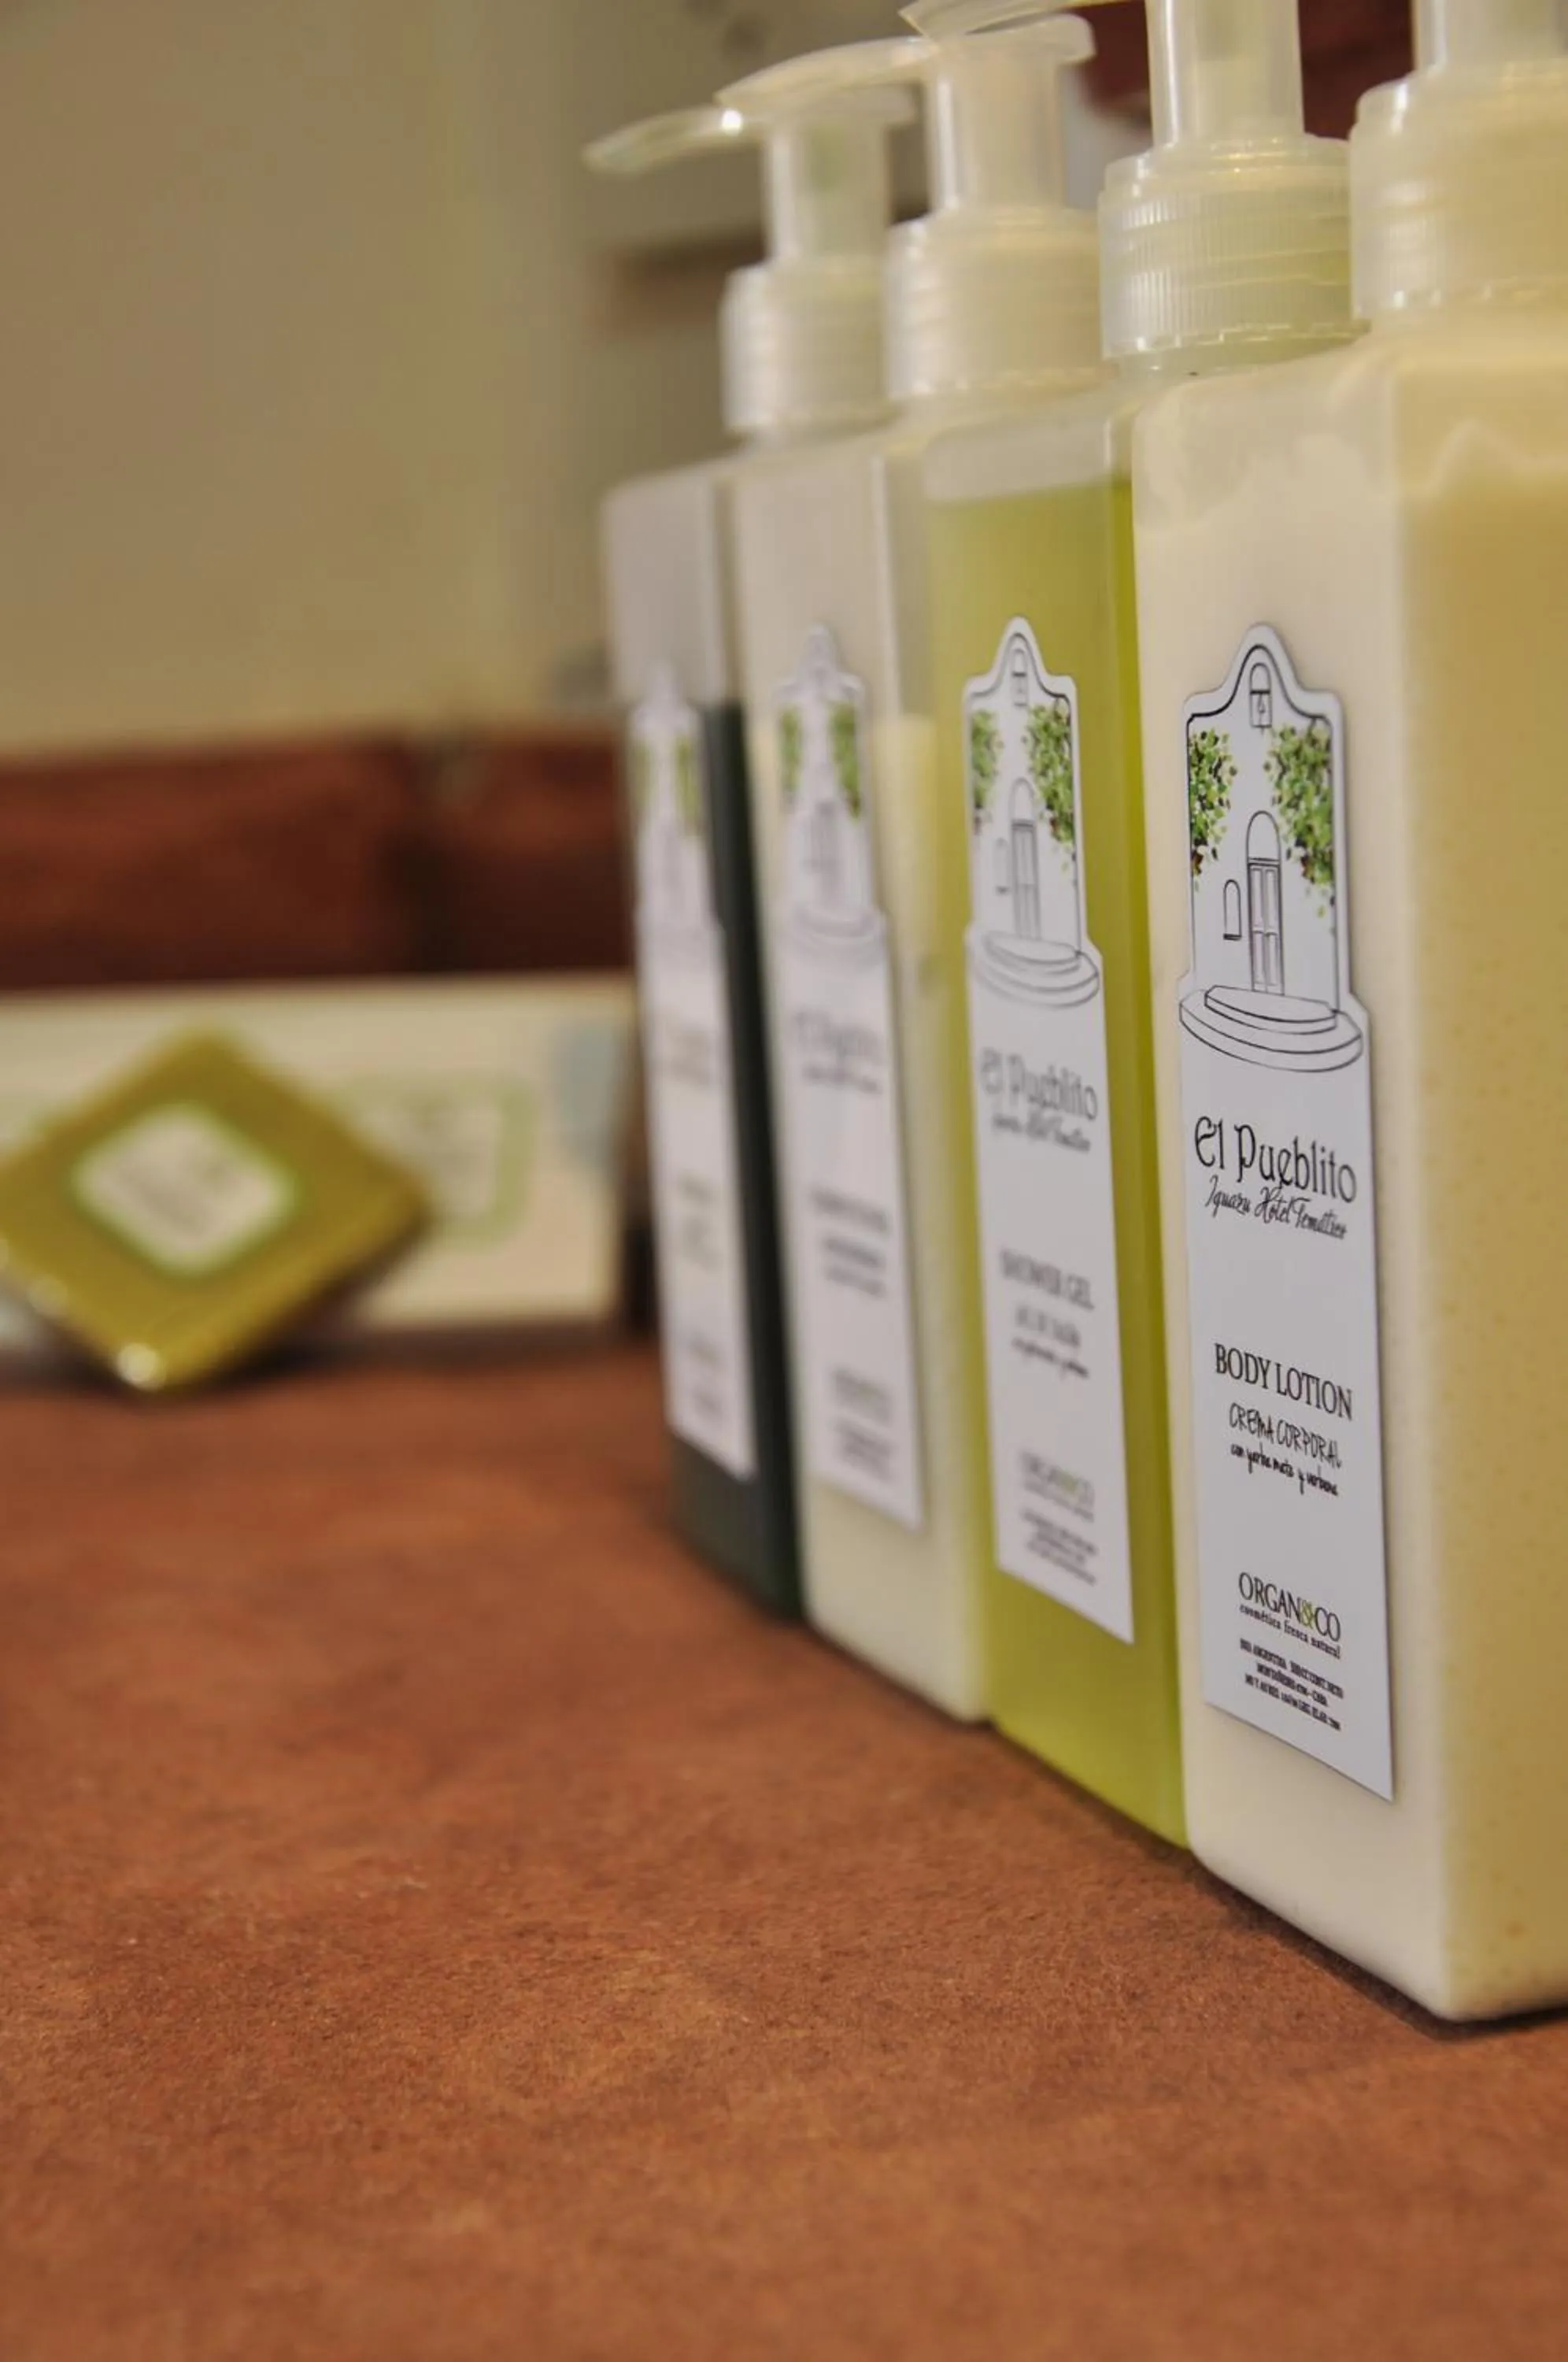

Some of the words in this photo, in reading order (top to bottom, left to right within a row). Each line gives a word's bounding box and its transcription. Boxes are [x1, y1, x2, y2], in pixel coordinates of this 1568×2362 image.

[1194, 1115, 1225, 1170] El
[1233, 1124, 1357, 1204] Pueblito
[1215, 1342, 1271, 1390] BODY
[1275, 1362, 1352, 1421] LOTION
[1230, 1401, 1274, 1444] CREMA
